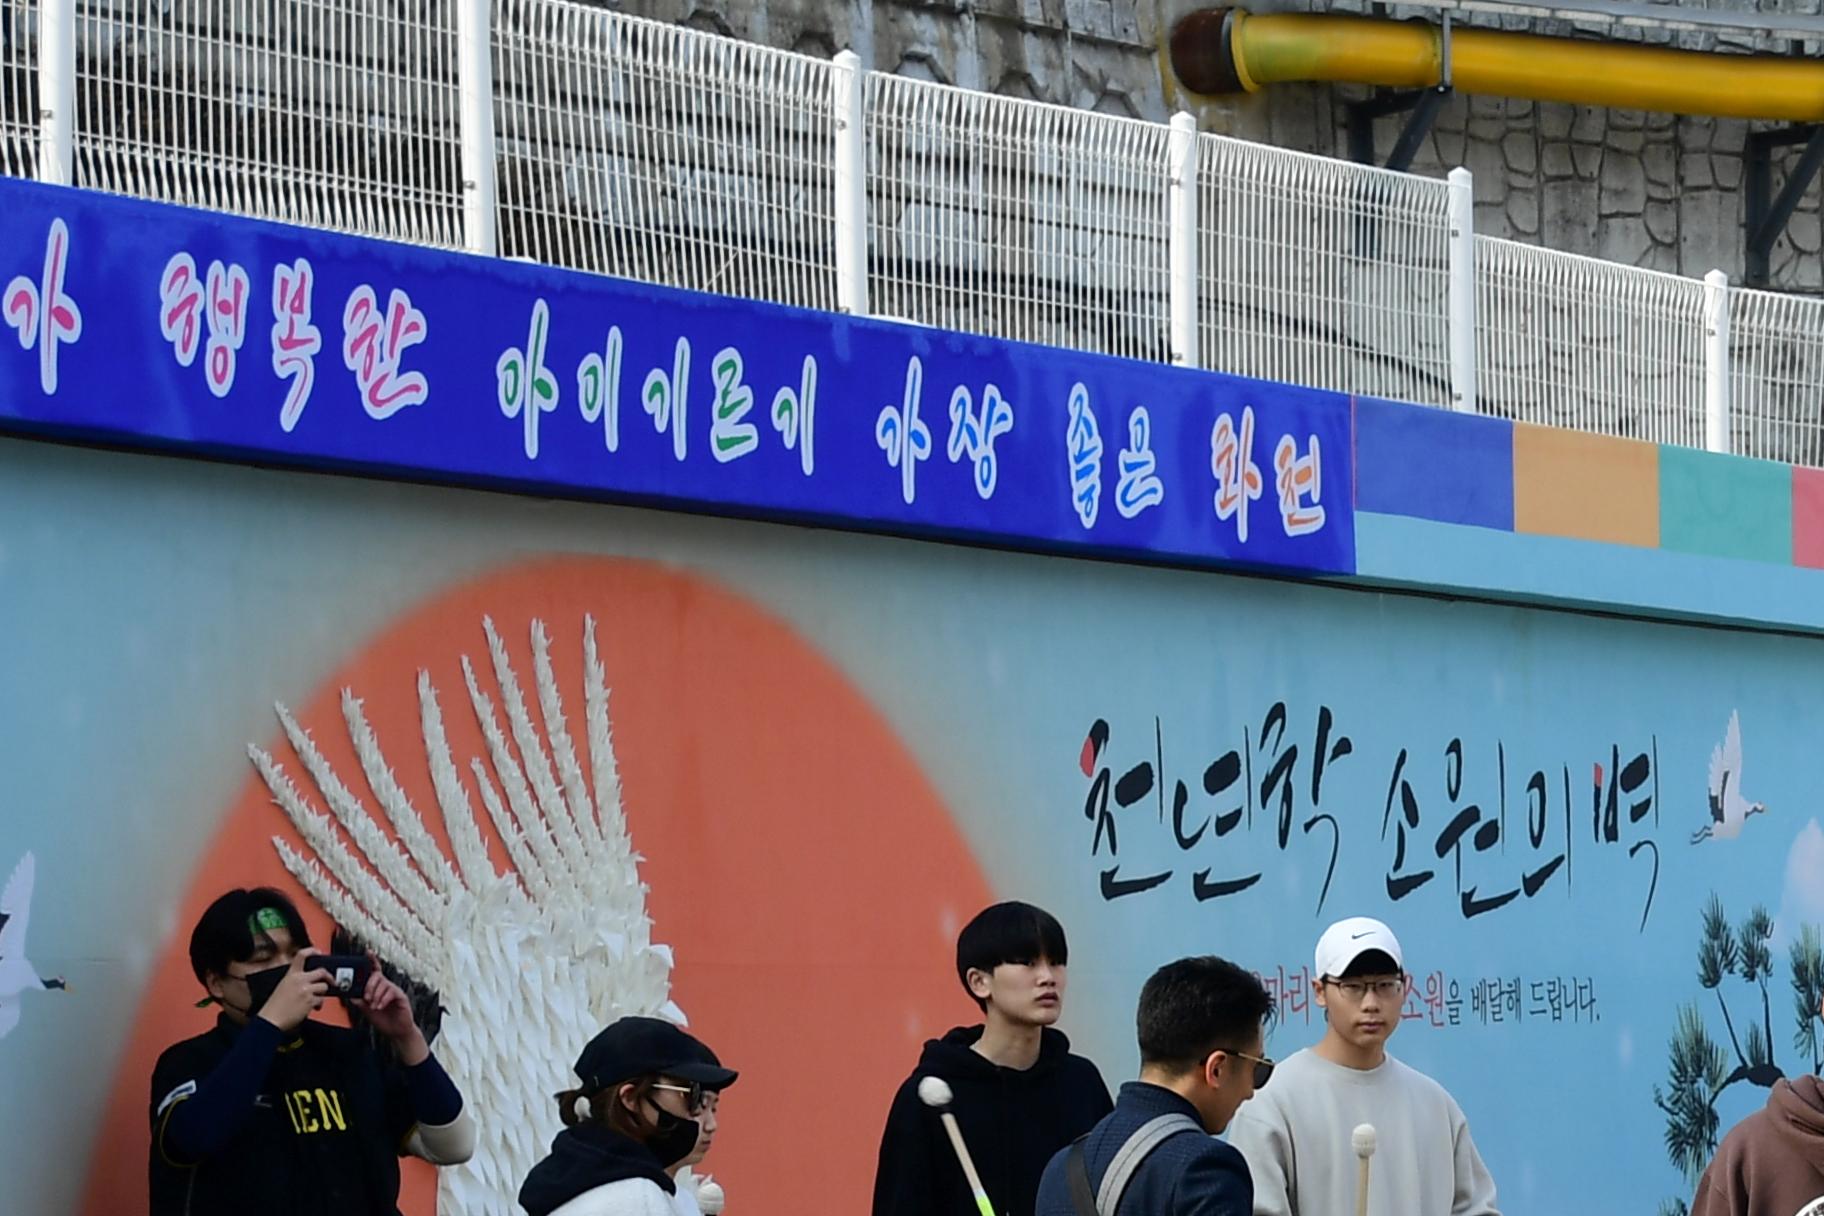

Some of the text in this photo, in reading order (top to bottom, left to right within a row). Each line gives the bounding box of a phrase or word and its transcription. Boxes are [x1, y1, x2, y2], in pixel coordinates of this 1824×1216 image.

[3, 217, 1326, 543] 가 행복한 아이기르기 가장 좋은 화천
[1079, 701, 1353, 918] 천년학
[1252, 965, 1601, 1027] 마리 소원을 배달해 드립니다.
